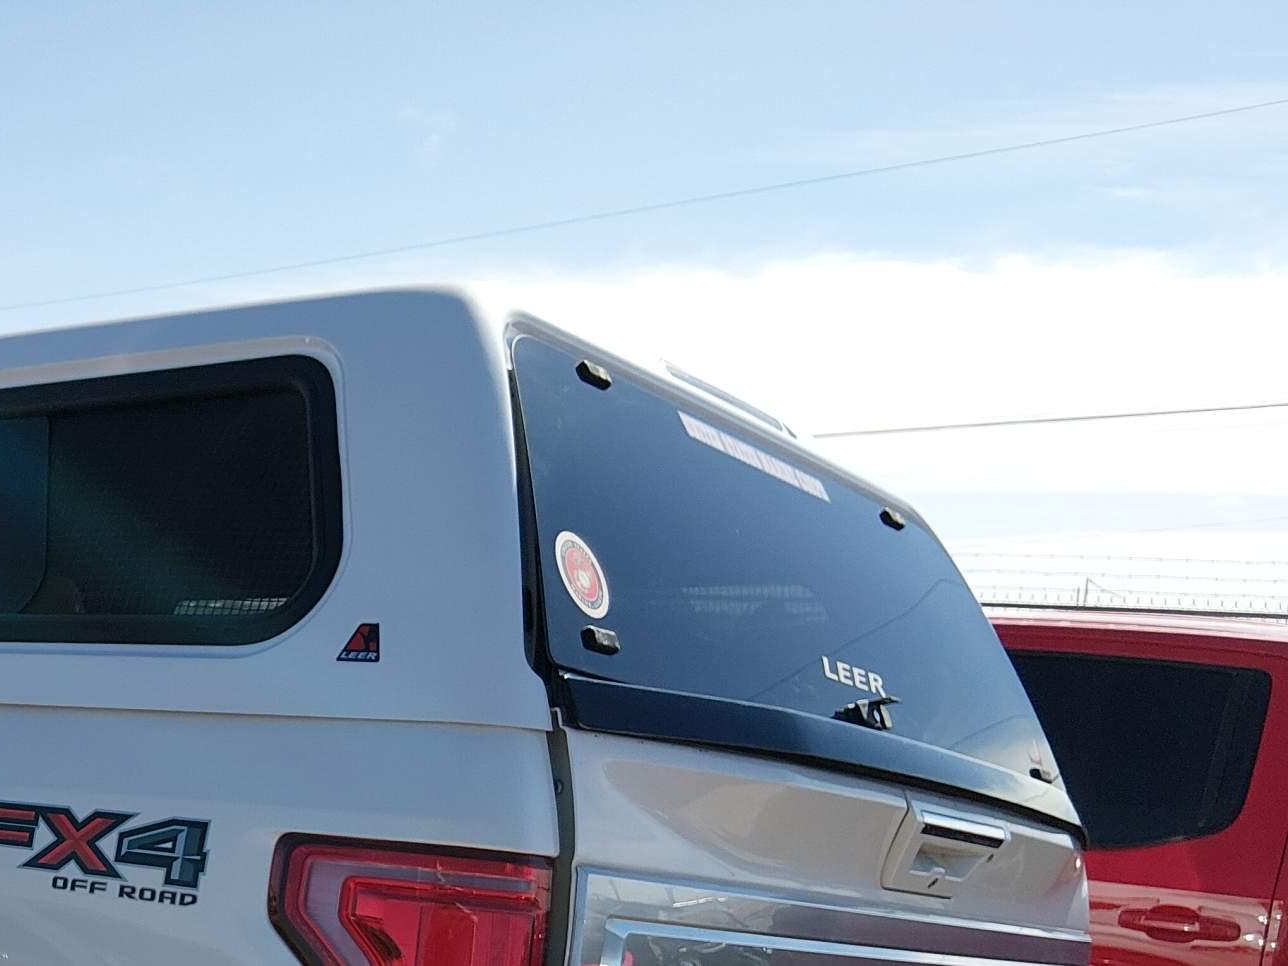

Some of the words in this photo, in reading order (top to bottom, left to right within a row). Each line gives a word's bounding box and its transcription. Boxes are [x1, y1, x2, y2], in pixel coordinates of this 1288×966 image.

[820, 655, 887, 699] LEER
[52, 876, 108, 894] OFF
[118, 884, 198, 906] ROAD
